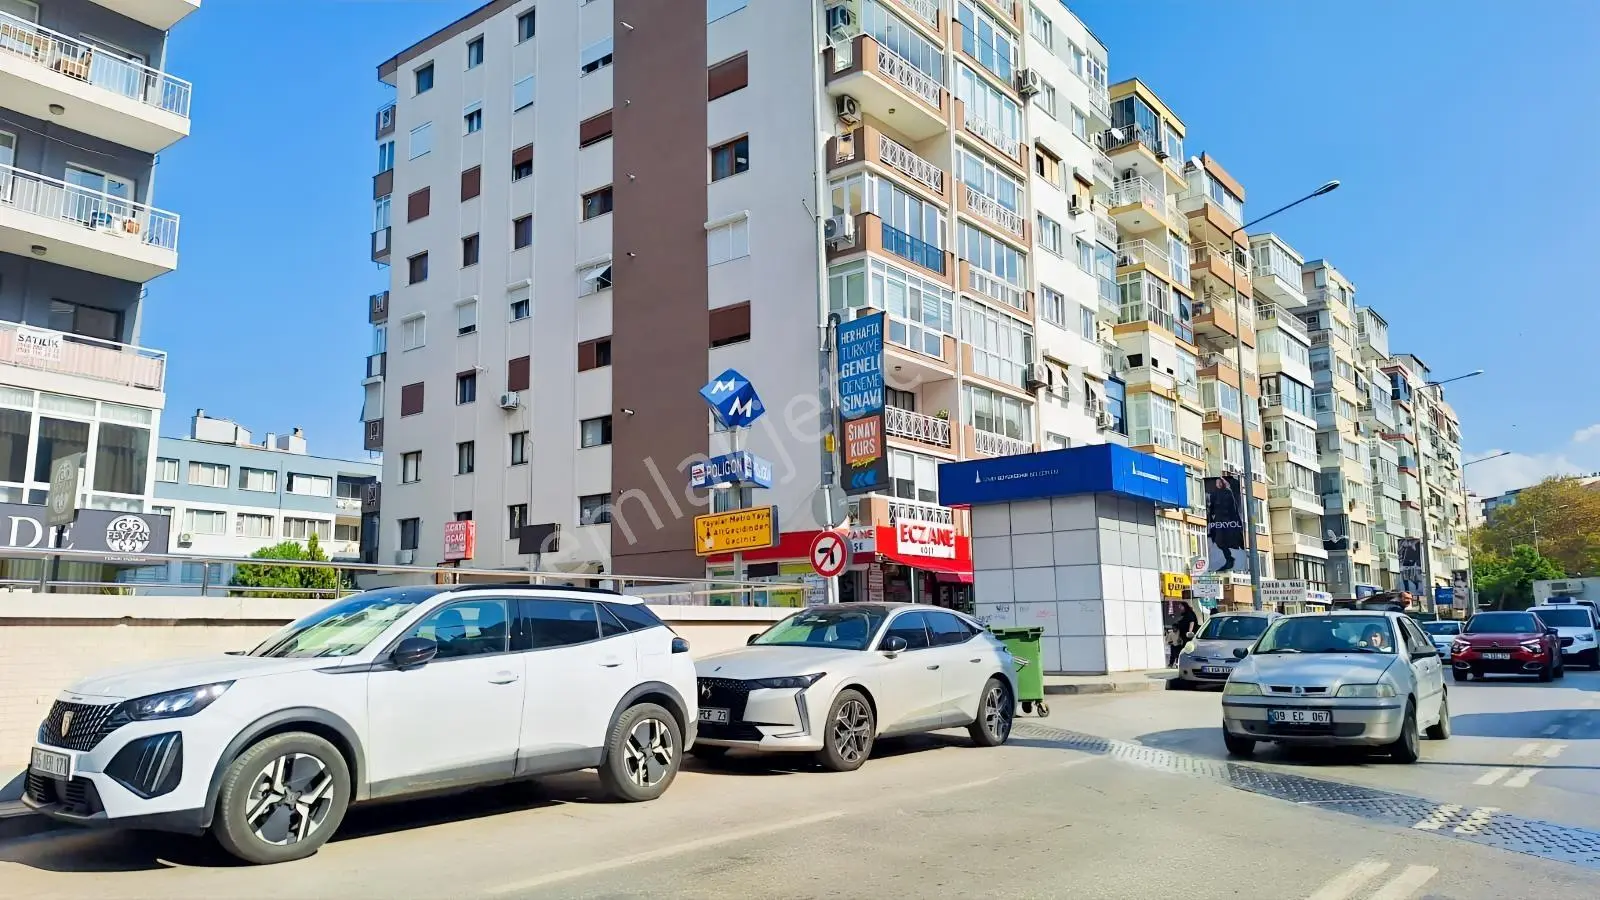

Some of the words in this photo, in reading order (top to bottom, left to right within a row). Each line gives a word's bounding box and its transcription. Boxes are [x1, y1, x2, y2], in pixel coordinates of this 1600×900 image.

[18, 333, 59, 348] SATILIK
[841, 330, 856, 345] HER
[856, 322, 880, 340] HAFTA
[711, 377, 735, 394] M
[842, 372, 881, 396] DENEME
[728, 396, 753, 418] M
[842, 387, 882, 412] SINAVI
[848, 420, 877, 441] SINAV
[850, 438, 876, 457] KURS
[107, 530, 150, 541] FEYZAN
[900, 523, 954, 547] ECZANE
[1274, 711, 1285, 720] 09
[1292, 711, 1304, 721] EC
[1312, 711, 1329, 721] 067
